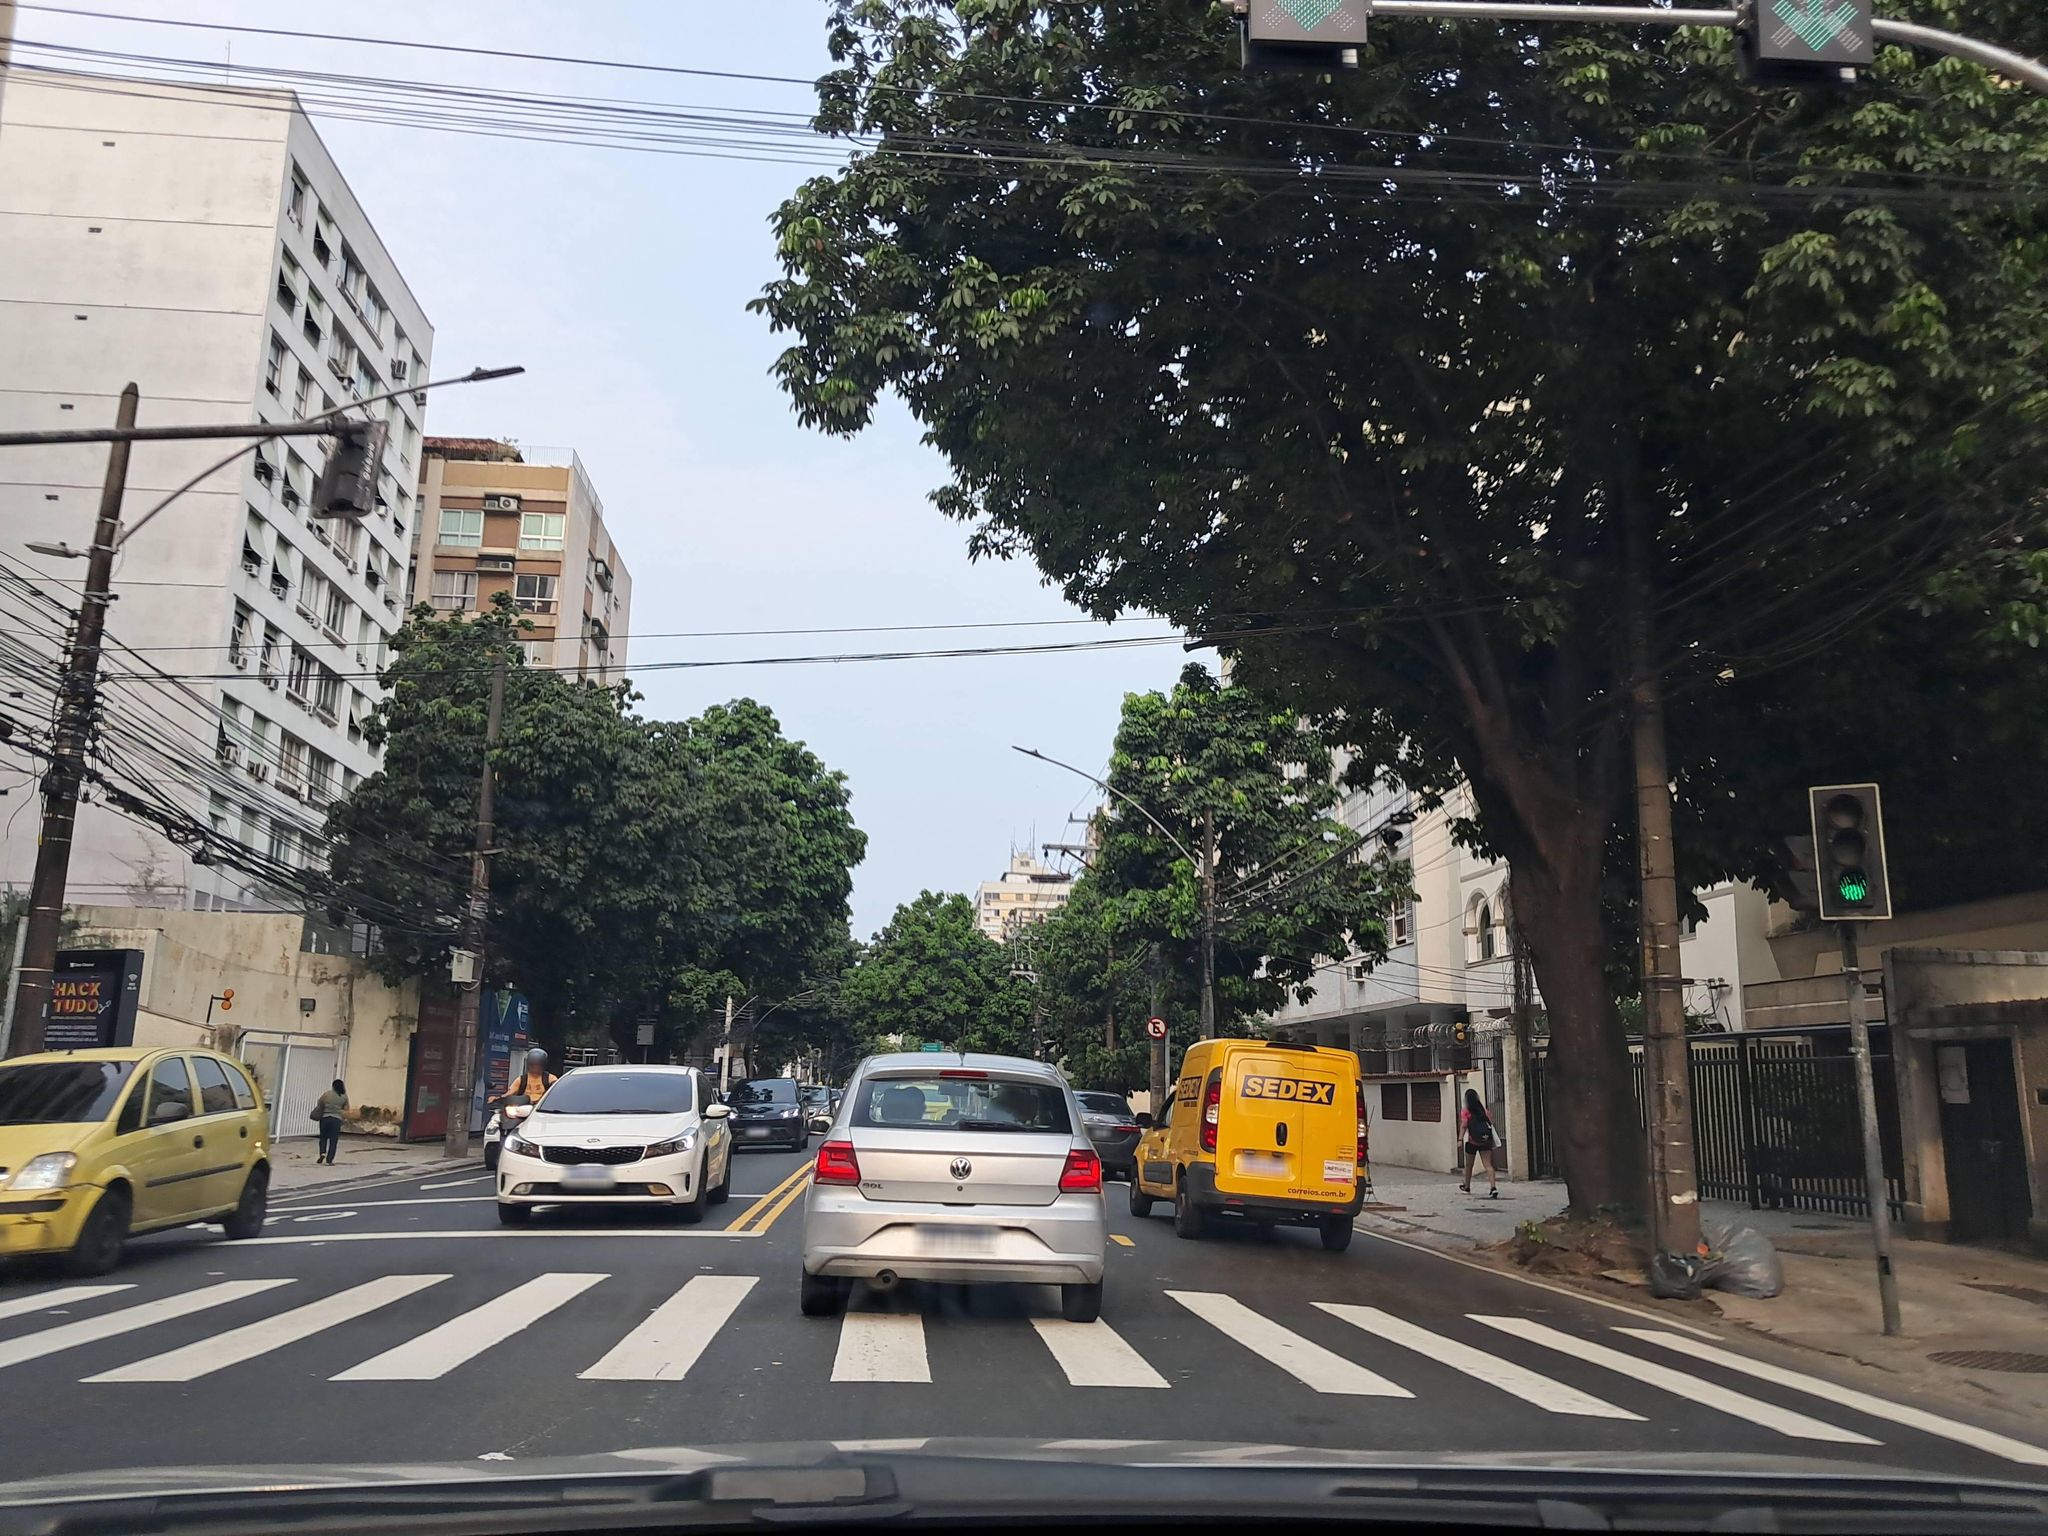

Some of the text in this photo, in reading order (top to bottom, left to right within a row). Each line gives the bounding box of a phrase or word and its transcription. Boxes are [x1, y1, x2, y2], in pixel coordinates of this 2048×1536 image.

[55, 982, 101, 996] HACK
[53, 999, 99, 1013] TUDO
[1244, 1077, 1332, 1103] SEDEX
[1287, 1187, 1347, 1198] correios.com.br
